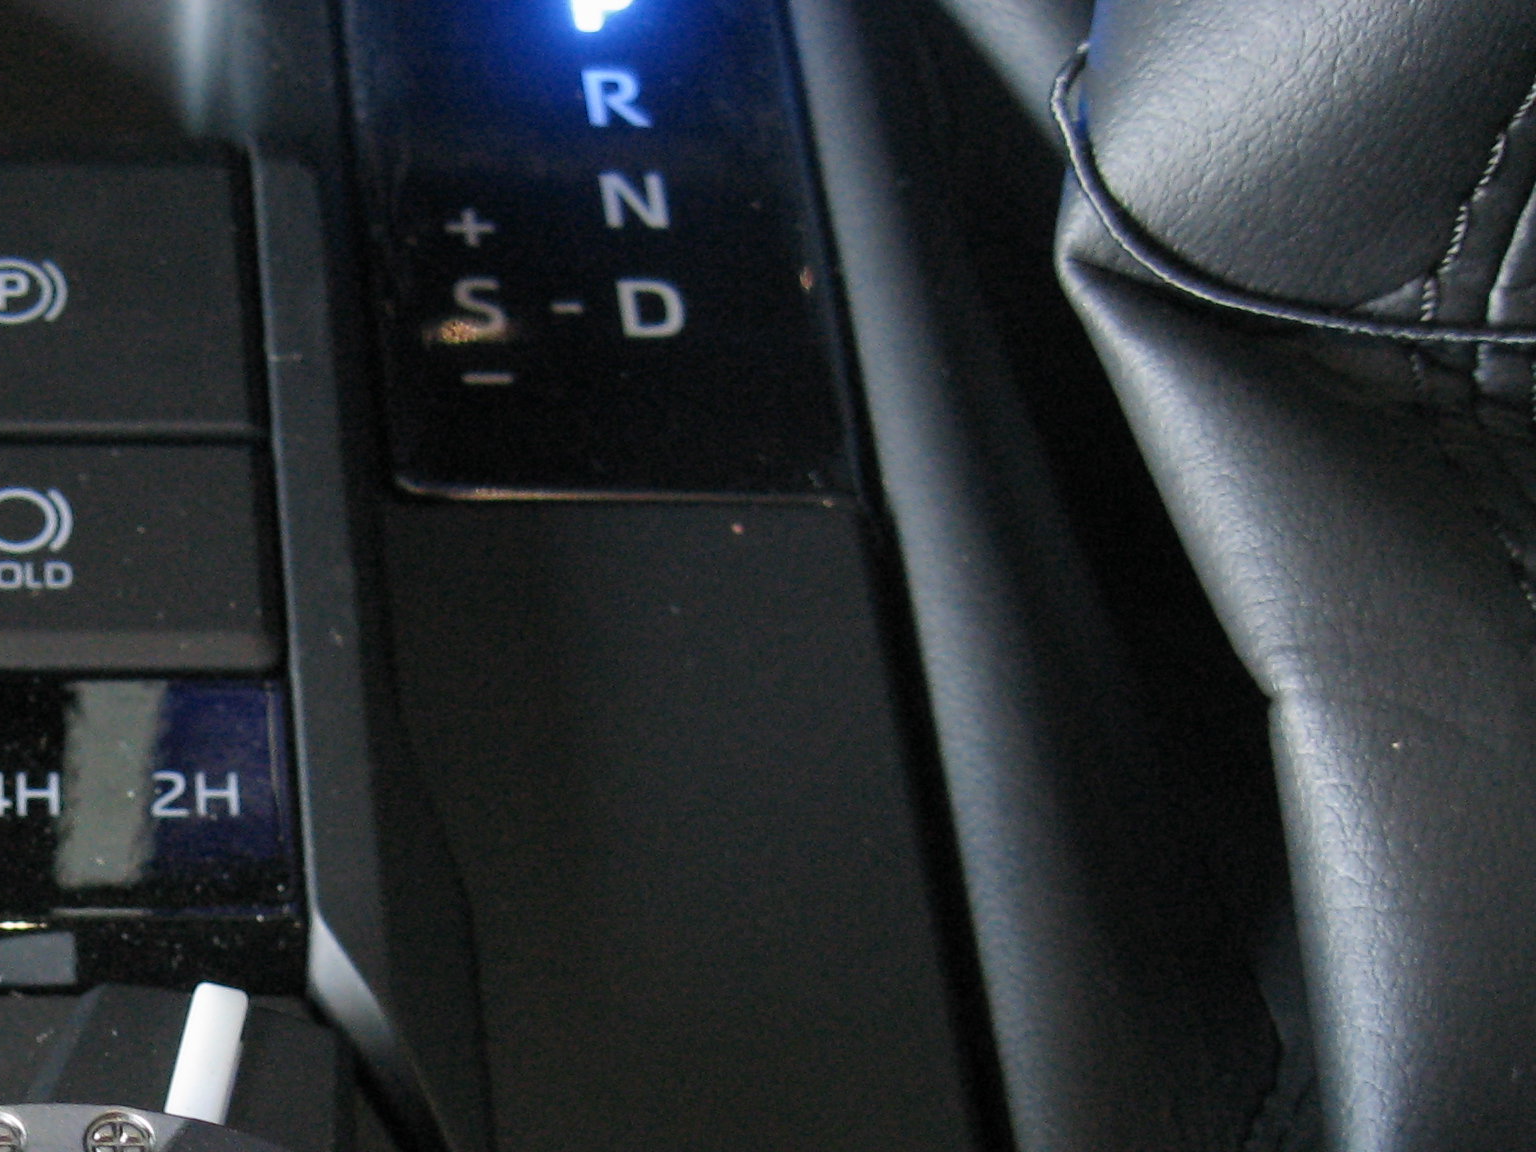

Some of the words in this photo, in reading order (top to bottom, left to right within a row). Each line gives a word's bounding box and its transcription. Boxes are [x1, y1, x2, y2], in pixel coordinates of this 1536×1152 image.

[581, 68, 651, 128] R
[598, 171, 670, 230] N
[452, 276, 507, 338] S
[616, 279, 686, 339] D
[150, 771, 242, 818] 2H
